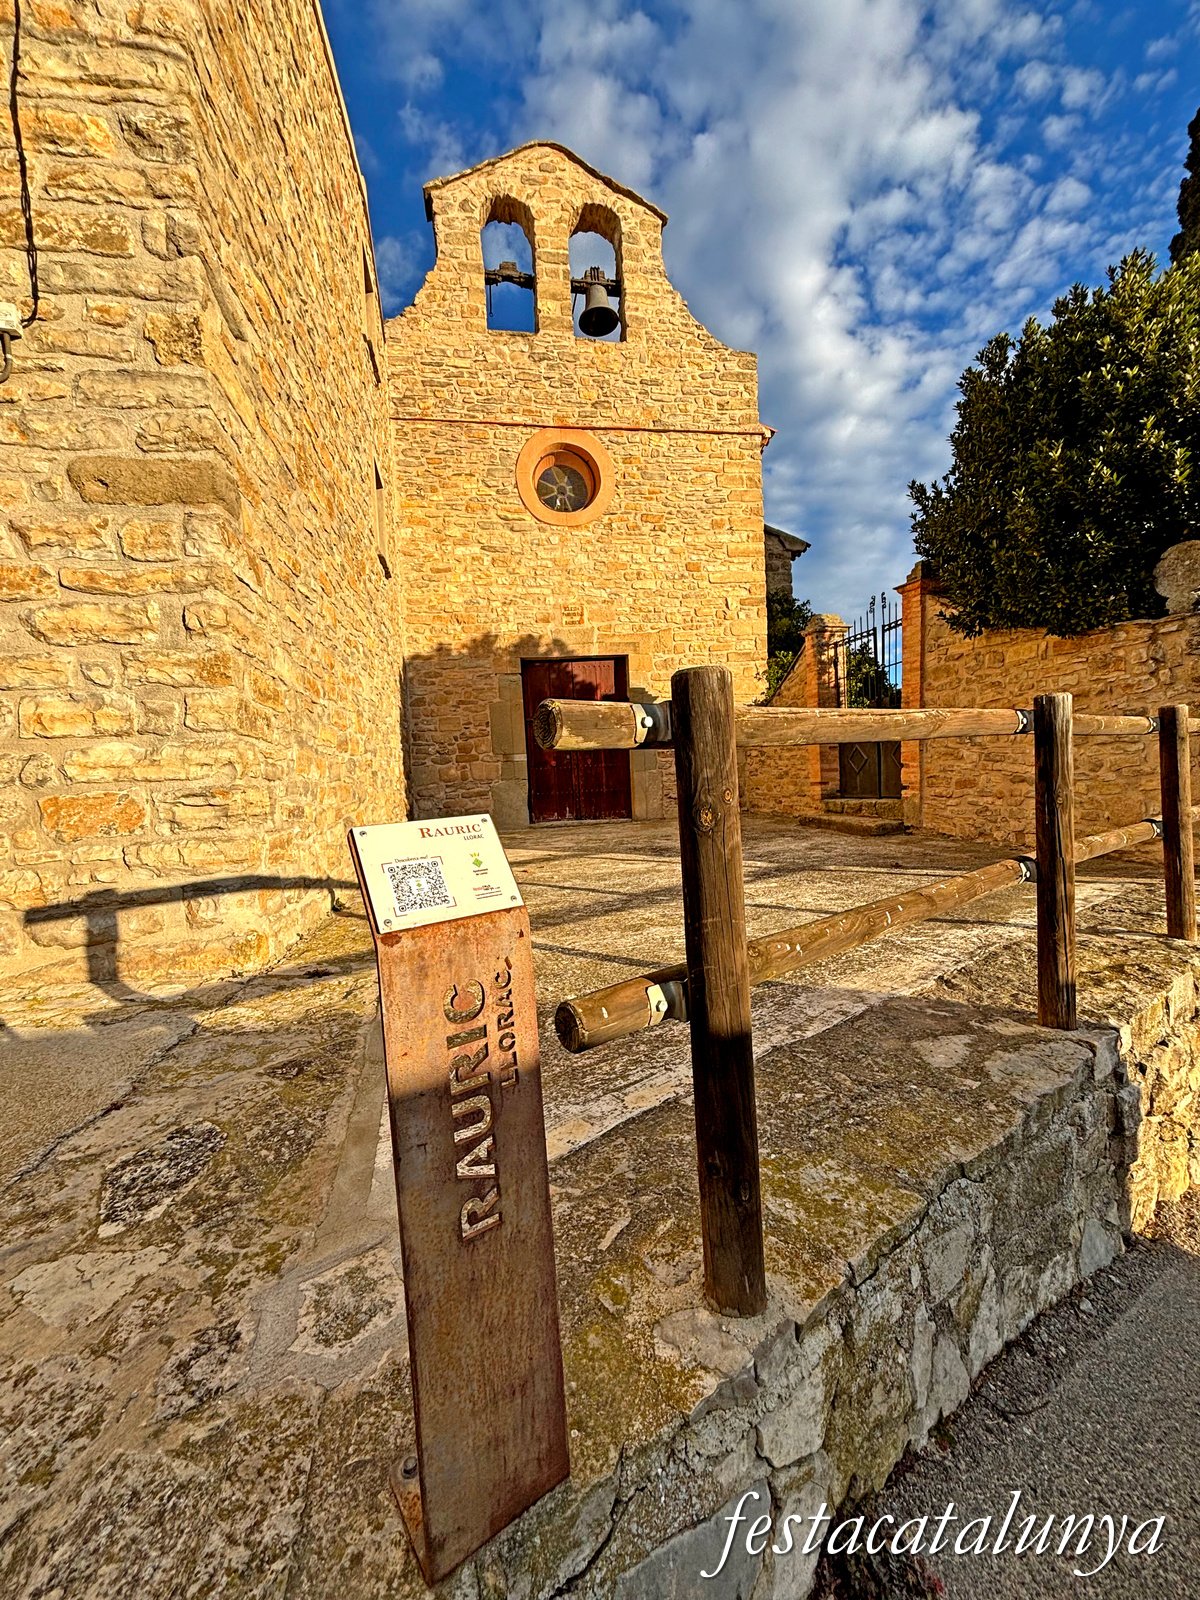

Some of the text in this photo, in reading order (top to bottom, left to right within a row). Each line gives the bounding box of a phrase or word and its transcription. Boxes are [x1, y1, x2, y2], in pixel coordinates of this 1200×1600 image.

[463, 833, 485, 841] LLORAC
[493, 968, 519, 1089] LLORAC
[443, 978, 502, 1242] RAURIC
